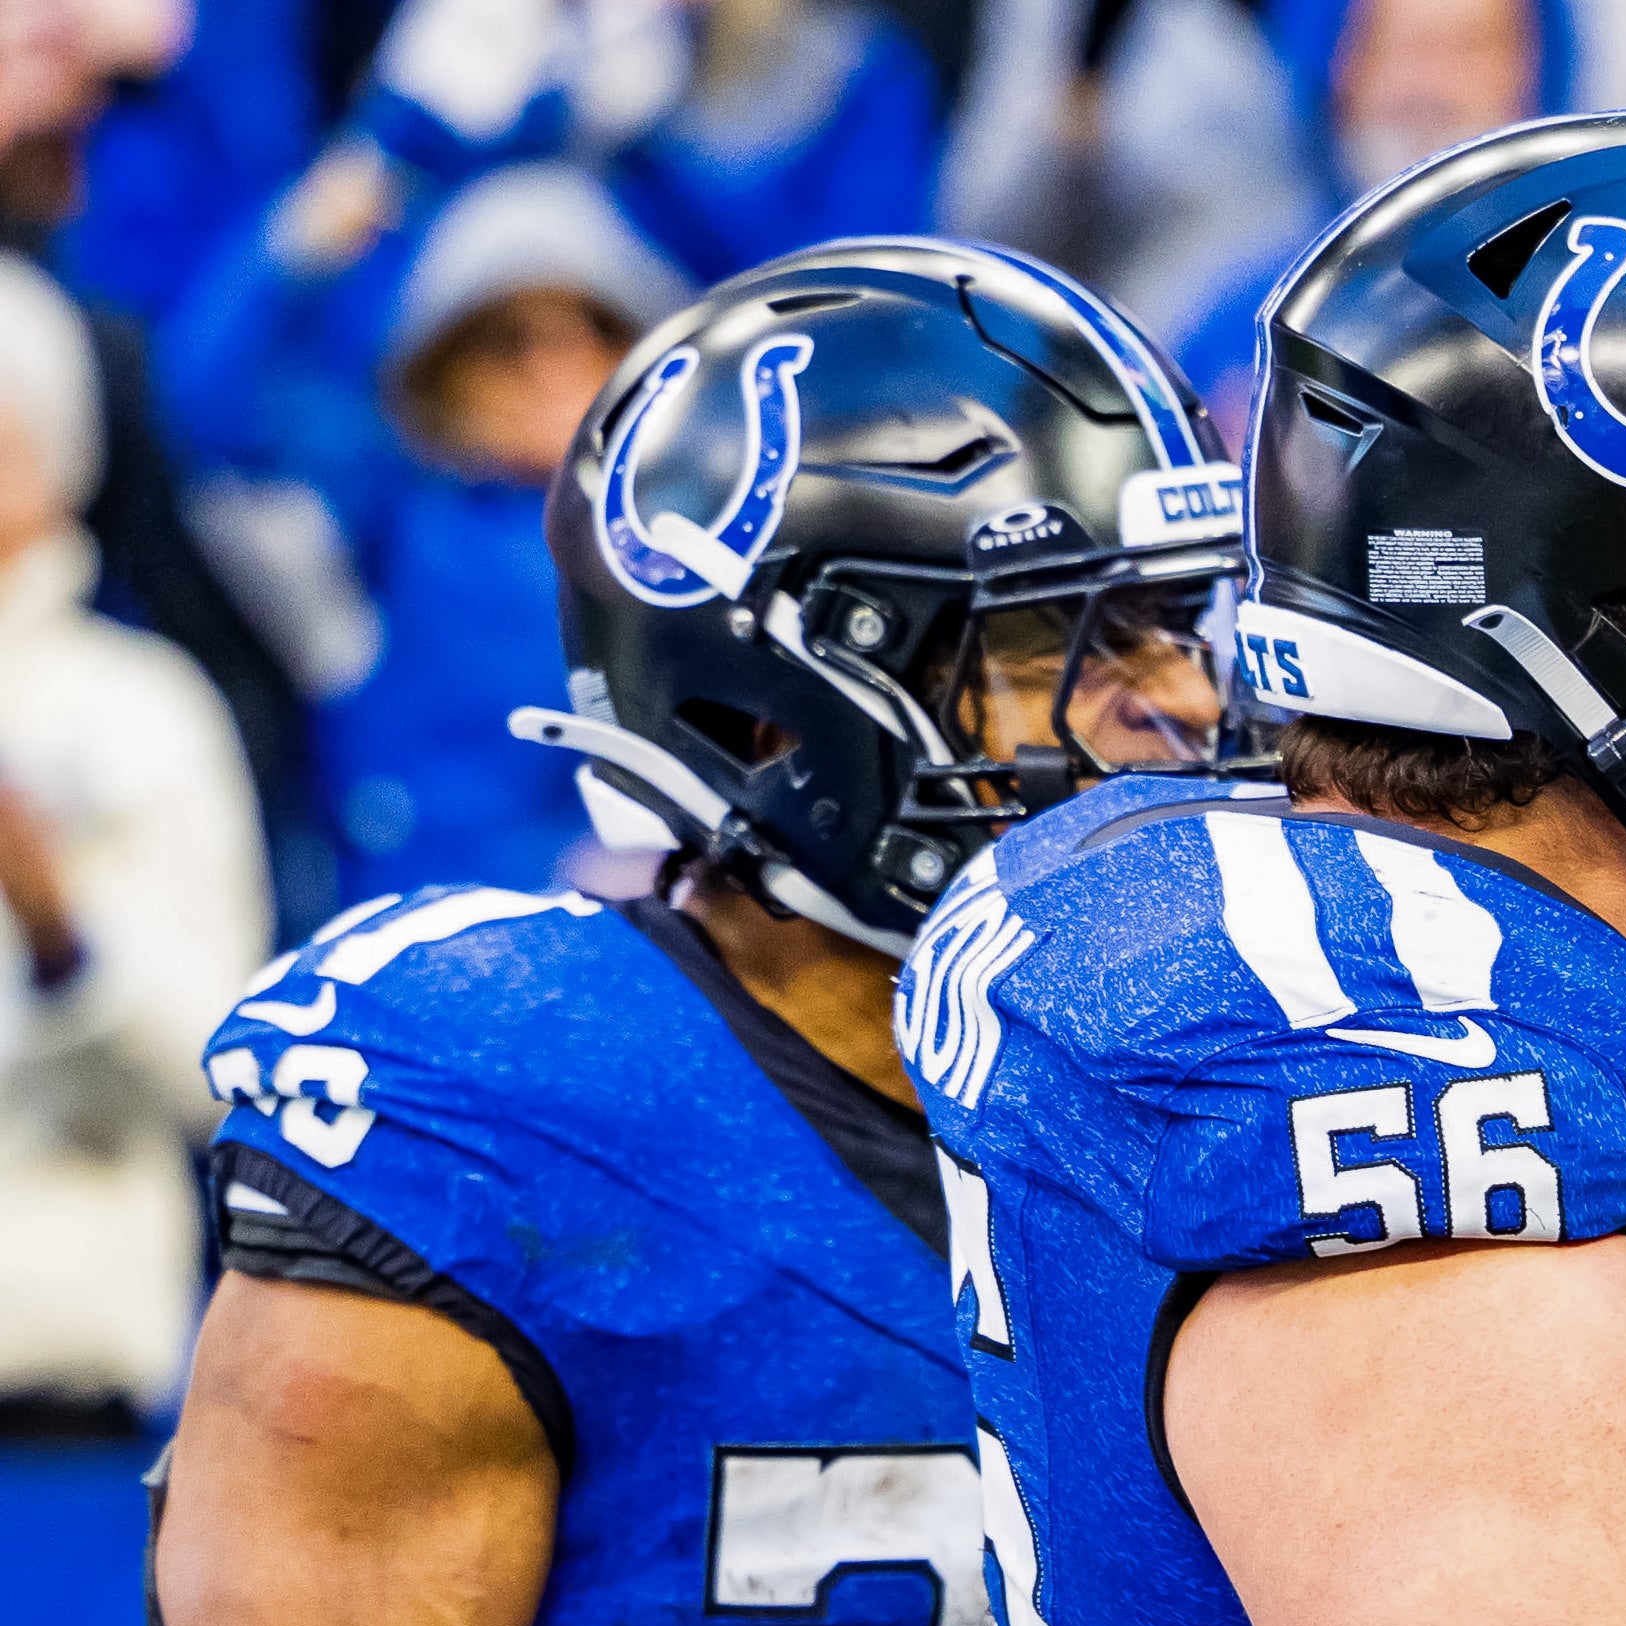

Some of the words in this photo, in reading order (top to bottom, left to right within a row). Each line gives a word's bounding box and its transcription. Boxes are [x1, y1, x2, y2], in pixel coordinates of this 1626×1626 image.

[1156, 478, 1243, 523] COLT
[1393, 529, 1453, 538] WARNING
[1234, 629, 1311, 698] LTS
[1288, 1068, 1568, 1259] 56
